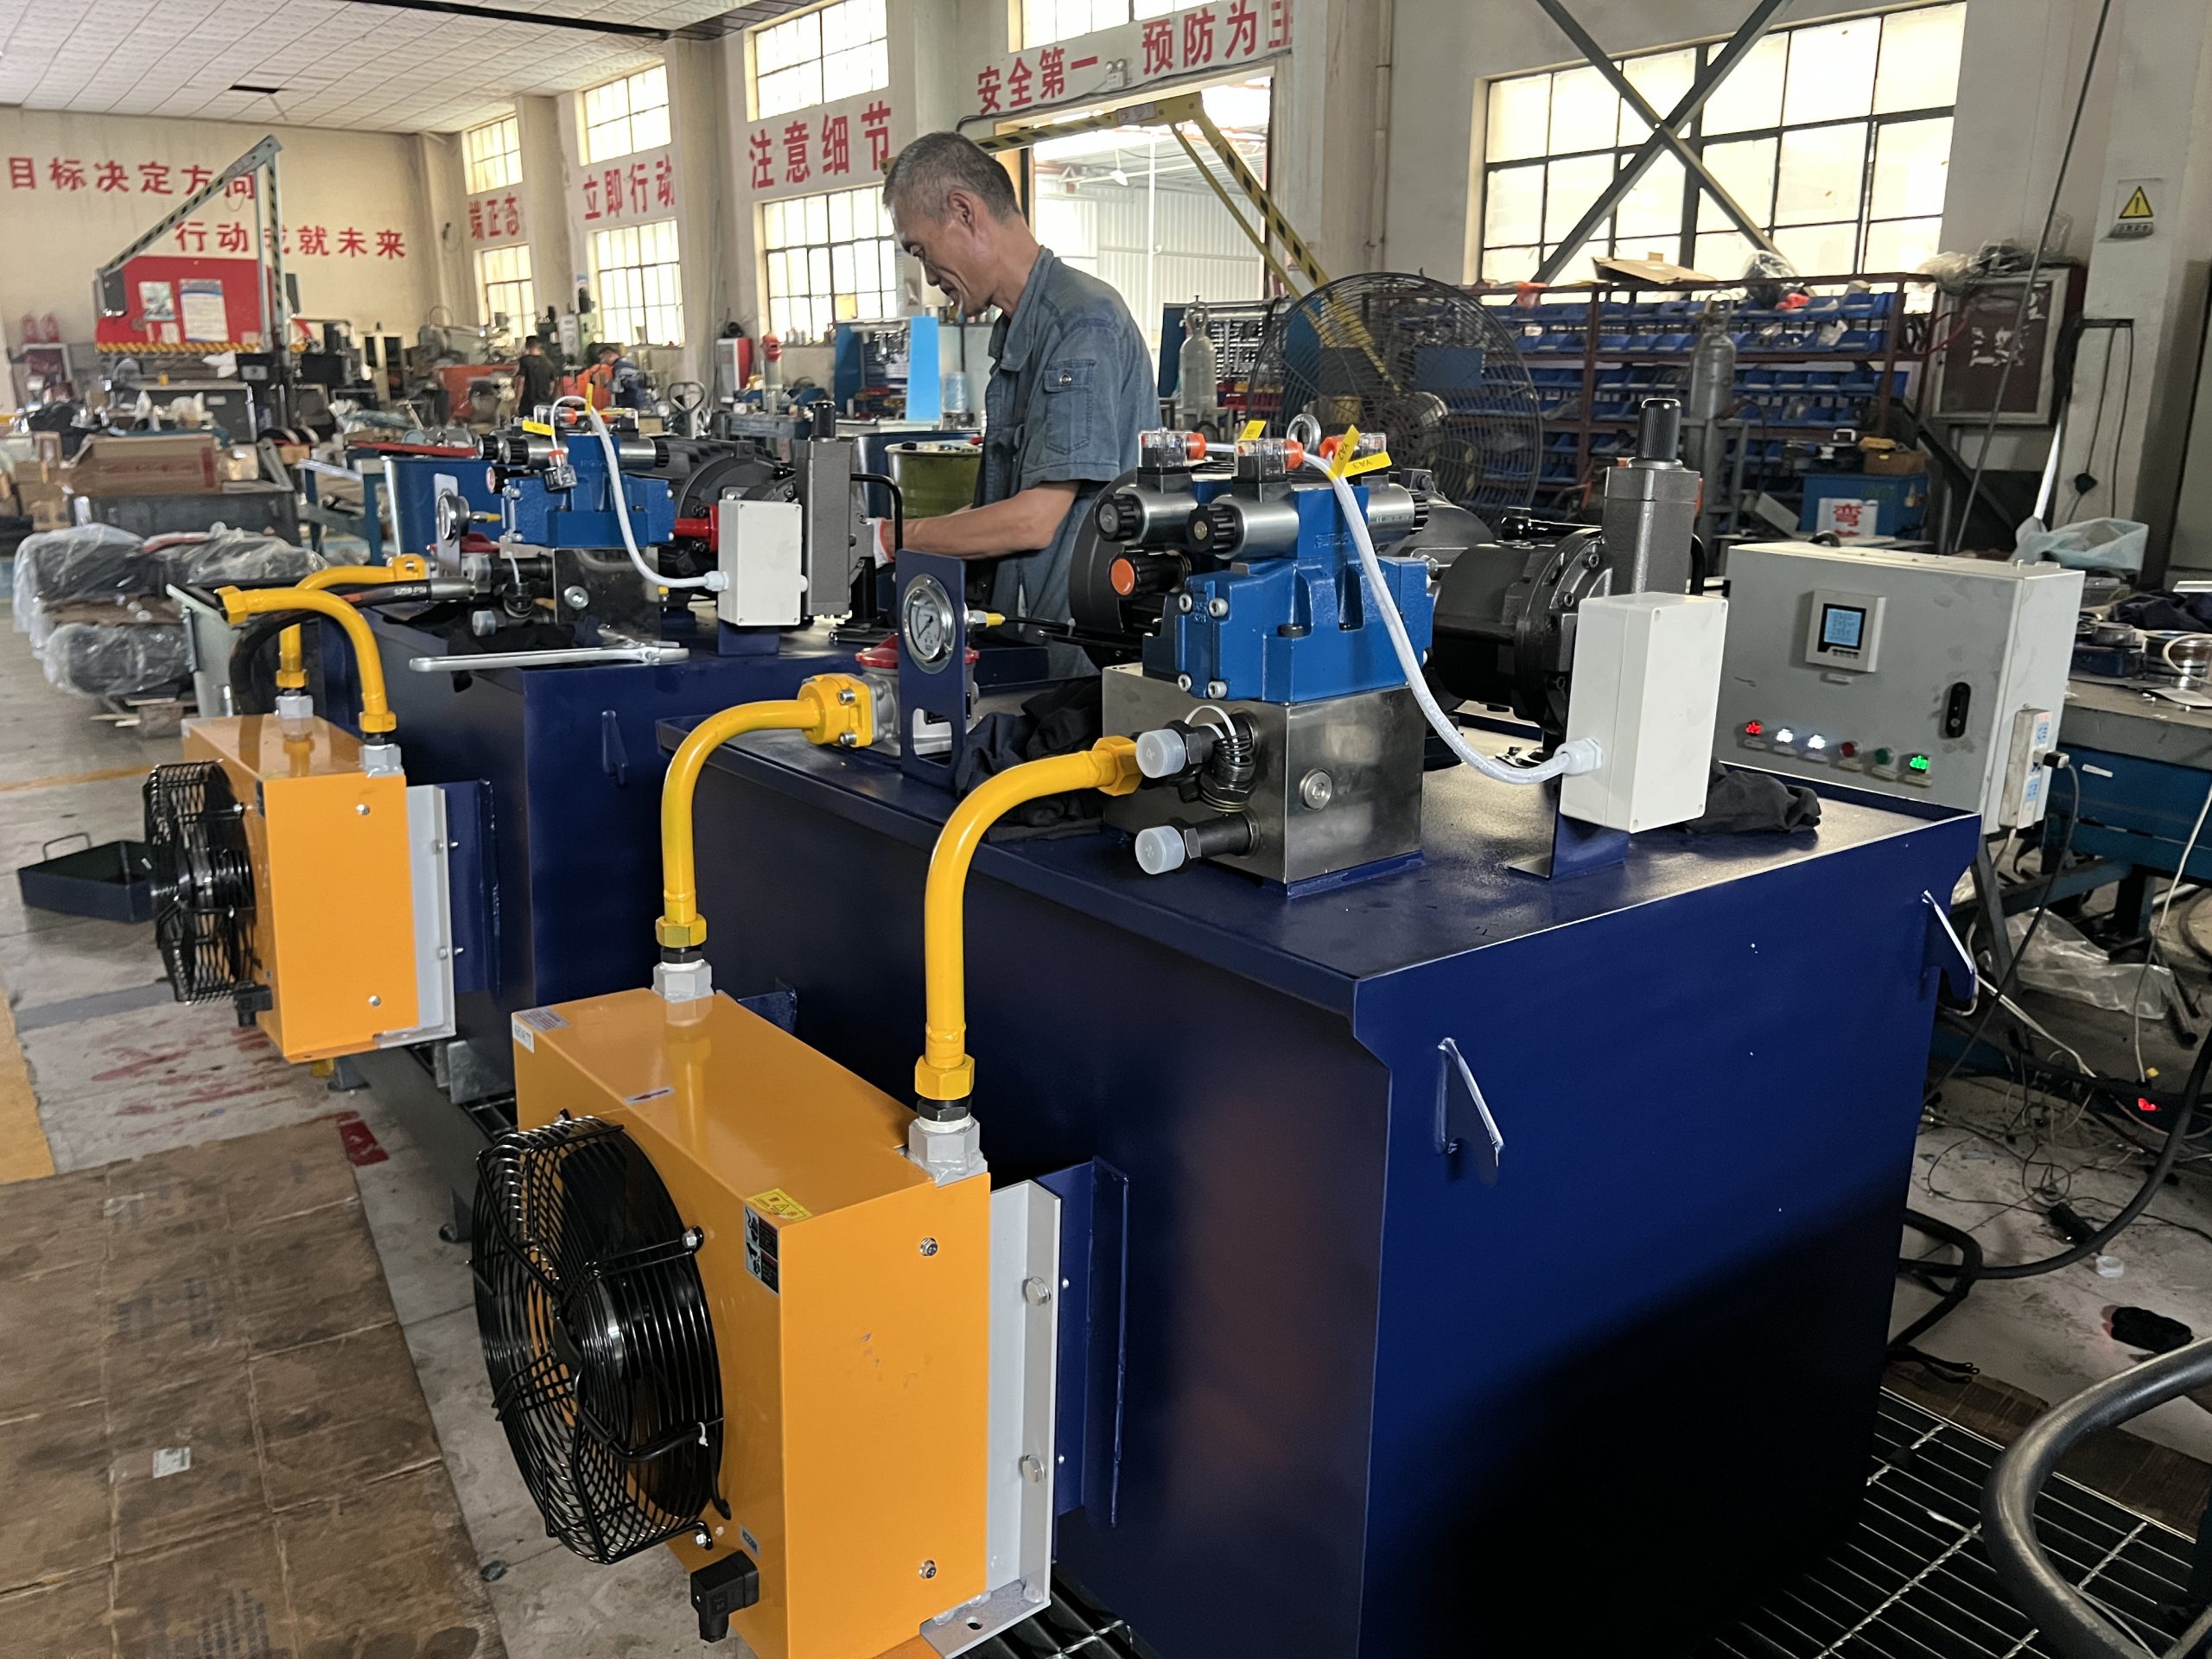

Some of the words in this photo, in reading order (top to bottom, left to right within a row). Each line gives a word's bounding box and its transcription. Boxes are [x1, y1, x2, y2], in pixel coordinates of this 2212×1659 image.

[977, 47, 1098, 116] 安全第一
[9, 156, 256, 200] 目标决定方向
[749, 100, 892, 190] 注意细节
[583, 154, 676, 220] 立即行动
